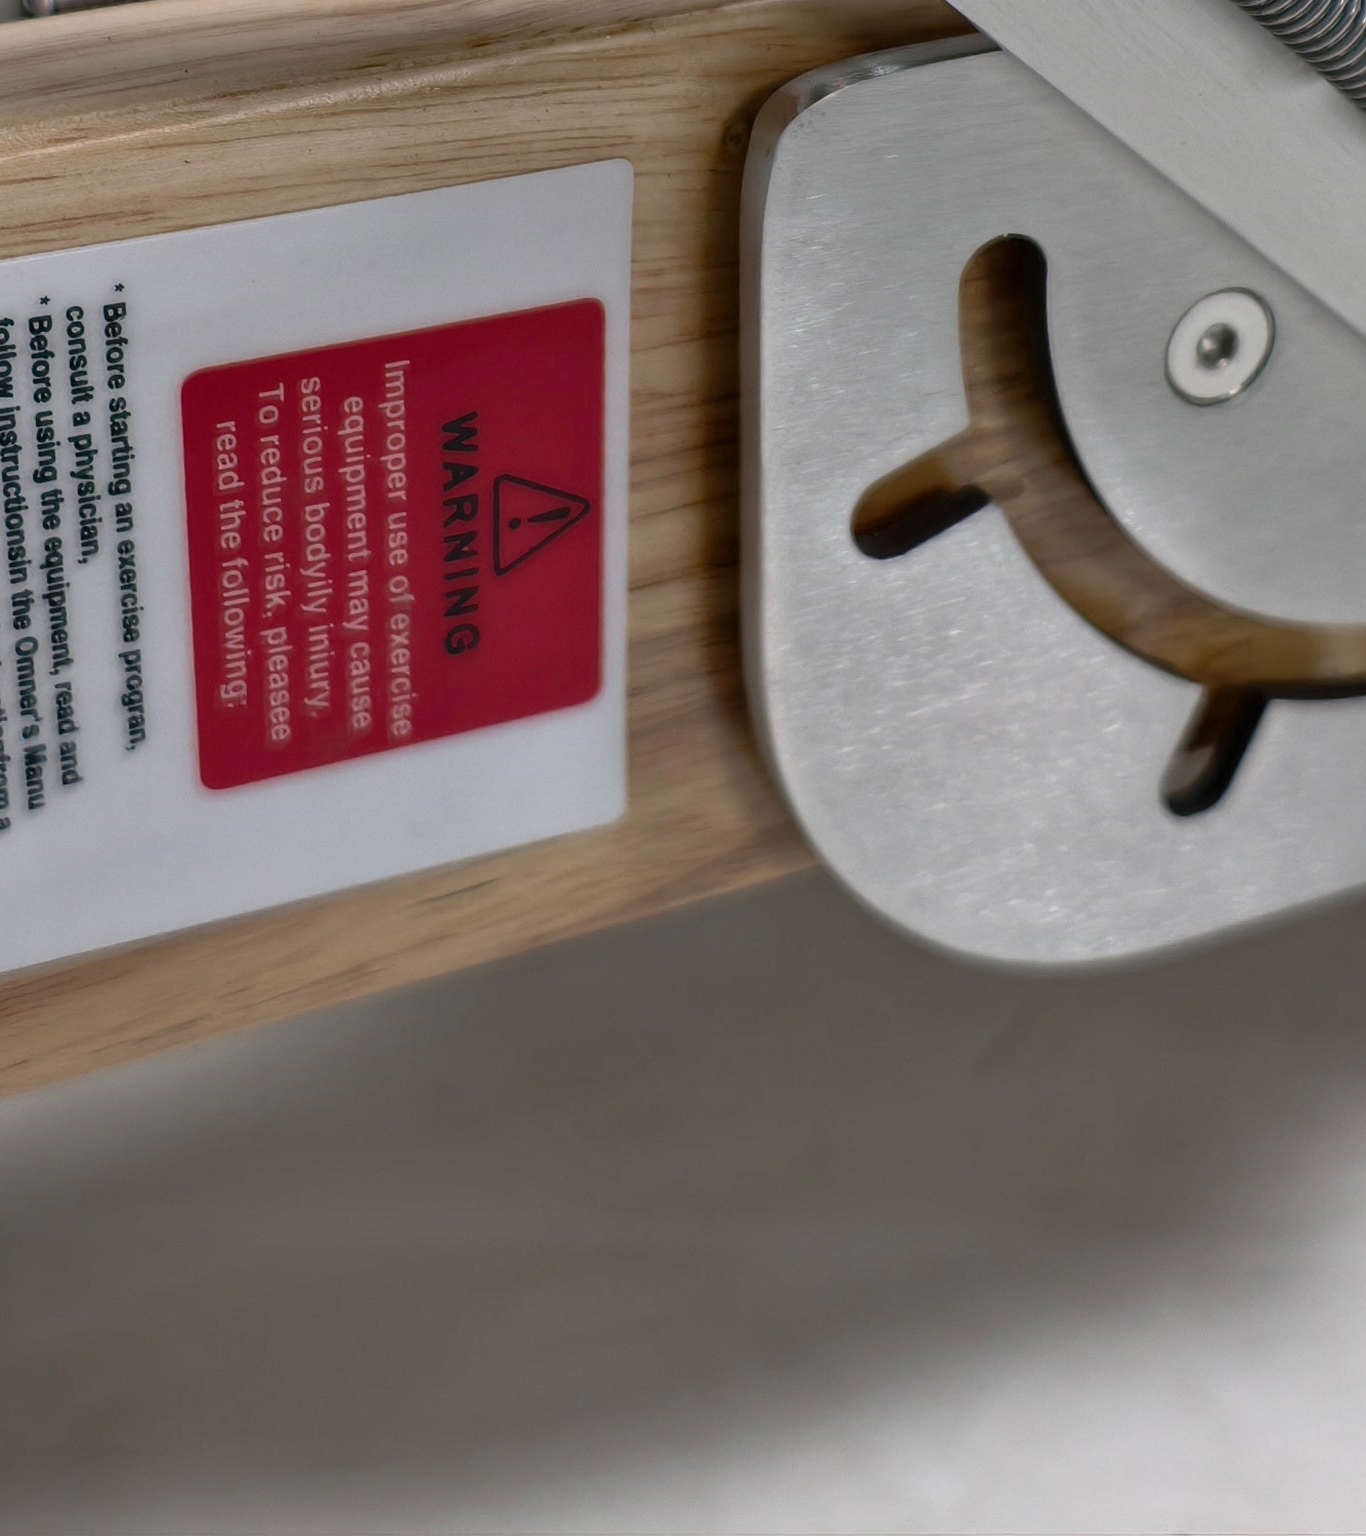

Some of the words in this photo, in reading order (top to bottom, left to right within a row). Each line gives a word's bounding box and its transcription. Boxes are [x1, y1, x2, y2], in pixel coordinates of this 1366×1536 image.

[27, 313, 56, 404] Before
[64, 304, 95, 406] consult
[101, 300, 129, 390] Before
[71, 409, 91, 428] a
[257, 381, 285, 425] To
[298, 375, 329, 494] serious
[376, 358, 411, 501] Improper
[31, 409, 61, 484] using
[106, 395, 136, 497] starting
[214, 419, 246, 493] read
[335, 395, 372, 562] equipment
[39, 487, 65, 531] the
[66, 432, 103, 565] physician,
[113, 501, 134, 533] an
[217, 497, 247, 550] the
[258, 433, 288, 543] reduce
[386, 510, 409, 567] use
[440, 410, 480, 656] WARNING
[9, 587, 36, 631] the
[38, 535, 74, 676] equipment,
[115, 538, 145, 644] exercise
[340, 568, 369, 633] may
[386, 574, 416, 604] of
[53, 680, 80, 736] read
[347, 640, 372, 731] cause
[388, 611, 418, 738] exercise
[22, 742, 47, 811] Manu
[58, 740, 83, 786] and
